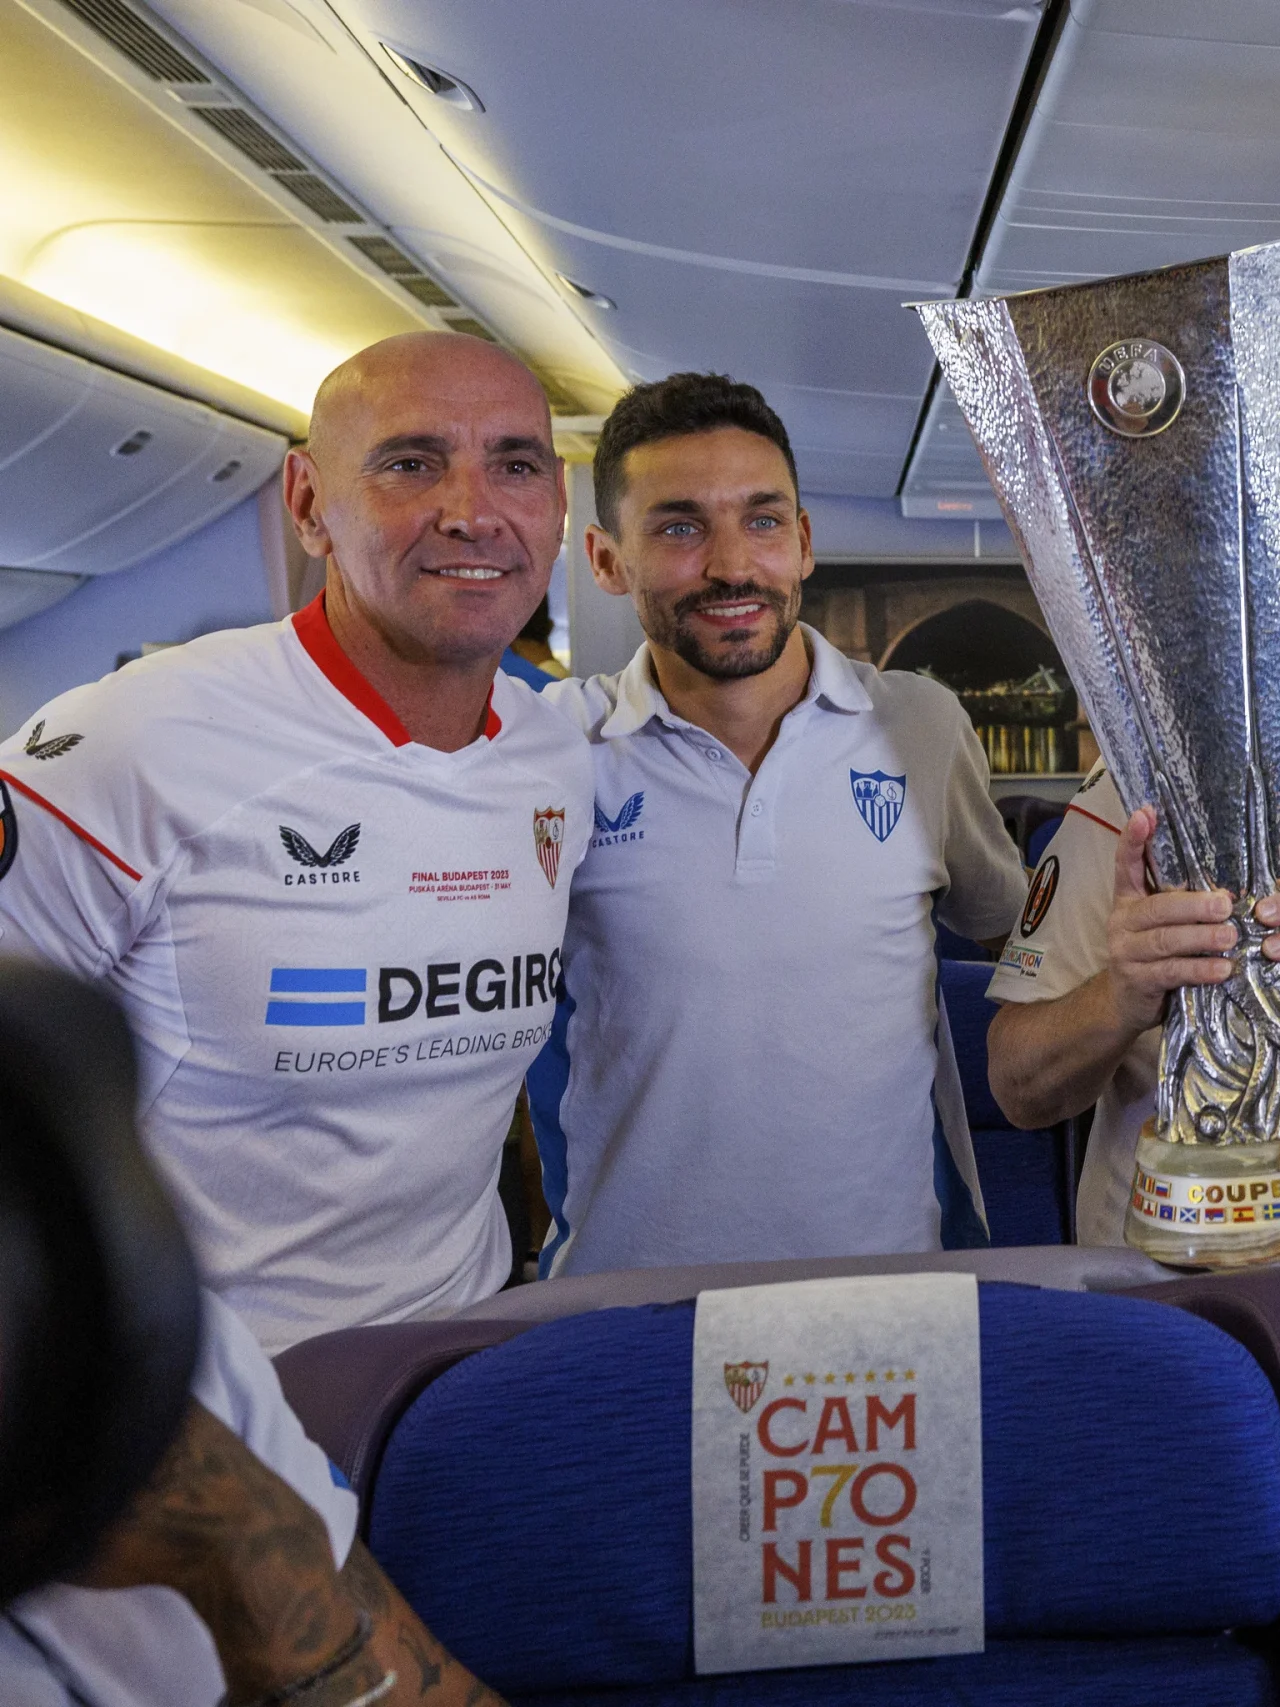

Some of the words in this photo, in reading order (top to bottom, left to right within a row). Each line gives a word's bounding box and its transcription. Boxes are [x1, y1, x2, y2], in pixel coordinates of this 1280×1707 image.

[1098, 343, 1158, 372] UEFA
[592, 830, 645, 848] CASTORE
[284, 870, 361, 886] CASTORE
[412, 873, 439, 881] FINAL
[442, 870, 488, 881] BUDAPEST
[490, 869, 509, 880] 2023
[459, 883, 490, 892] BUDAPEST
[274, 1045, 409, 1073] EUROPE'S
[416, 1032, 505, 1061] LEADING
[757, 1393, 917, 1458] CAM
[761, 1533, 916, 1604] NES
[761, 1606, 859, 1628] BUDAPEST
[865, 1603, 918, 1624] 2023
